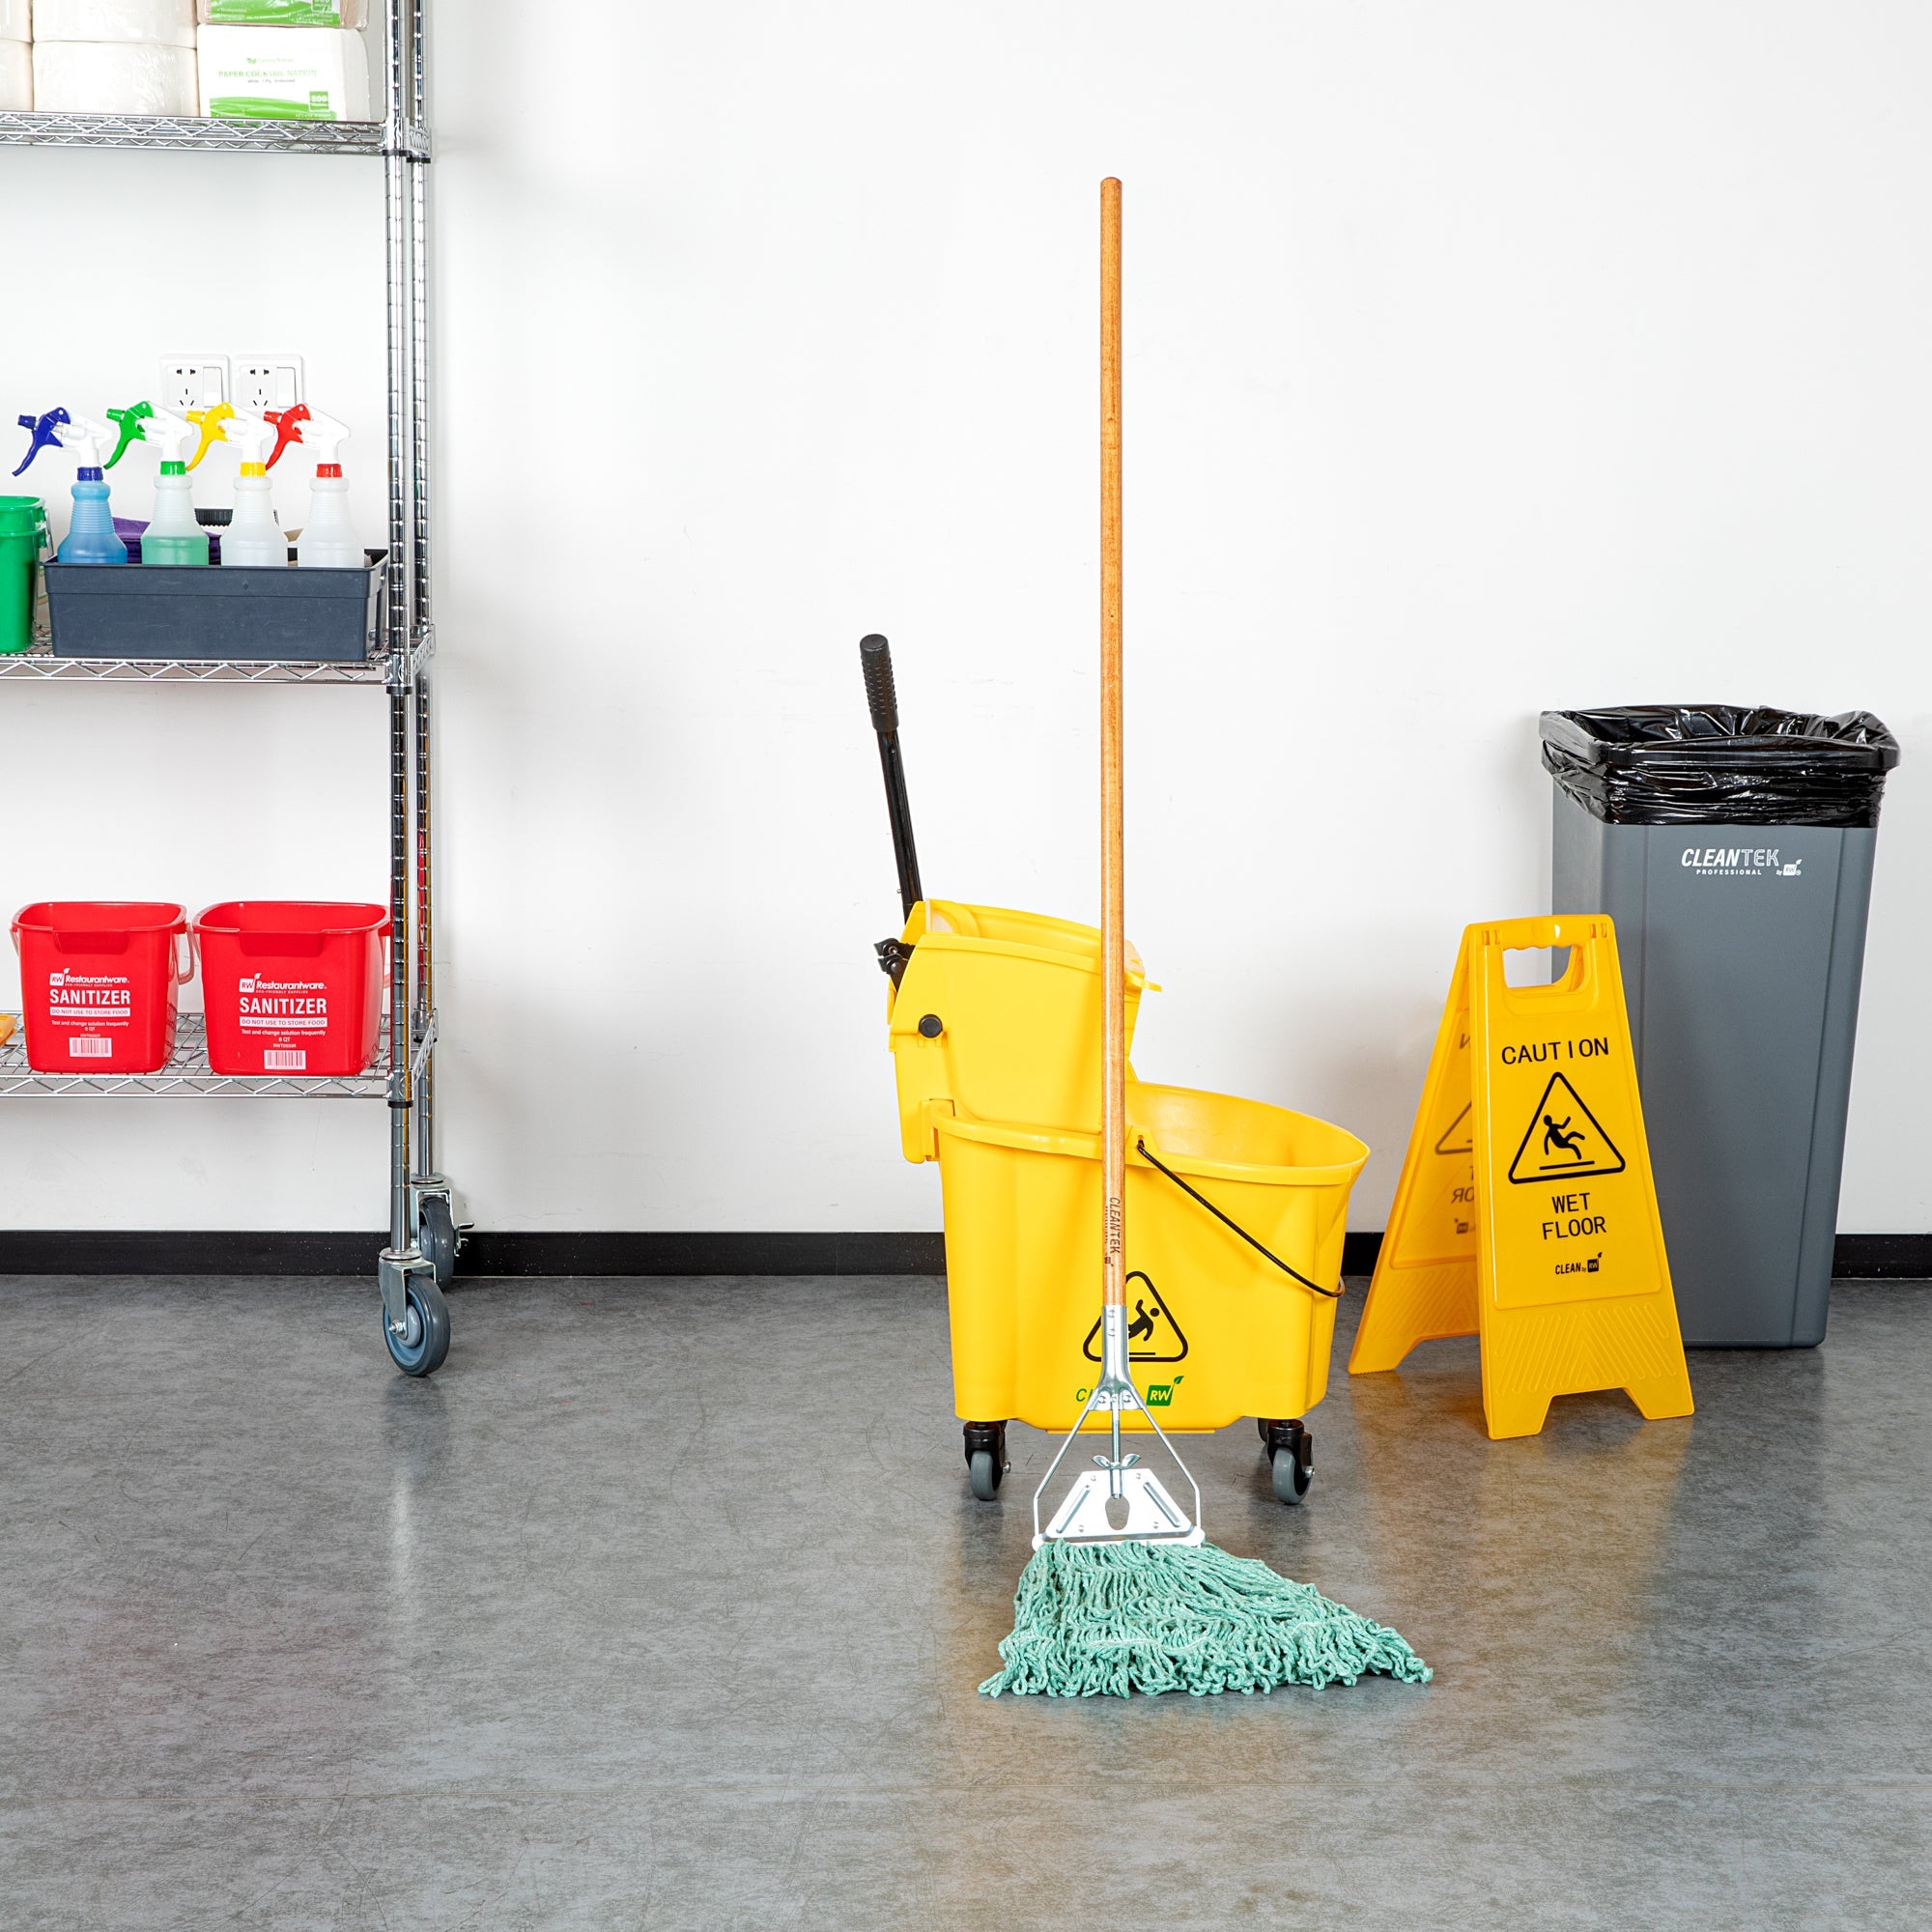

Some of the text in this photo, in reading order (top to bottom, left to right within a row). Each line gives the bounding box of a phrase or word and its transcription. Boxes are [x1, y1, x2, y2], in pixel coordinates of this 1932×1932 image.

[1681, 848, 1779, 867] CLEANTEK
[49, 989, 130, 1005] SANITIZER
[240, 997, 327, 1014] SANITIZER
[1501, 1037, 1608, 1065] CAUTION
[1551, 1192, 1590, 1213] WET
[1109, 1197, 1121, 1254] CLEANTEK
[1542, 1216, 1606, 1240] FLOOR
[1554, 1262, 1581, 1275] CLEAN
[1150, 1390, 1171, 1401] RW
